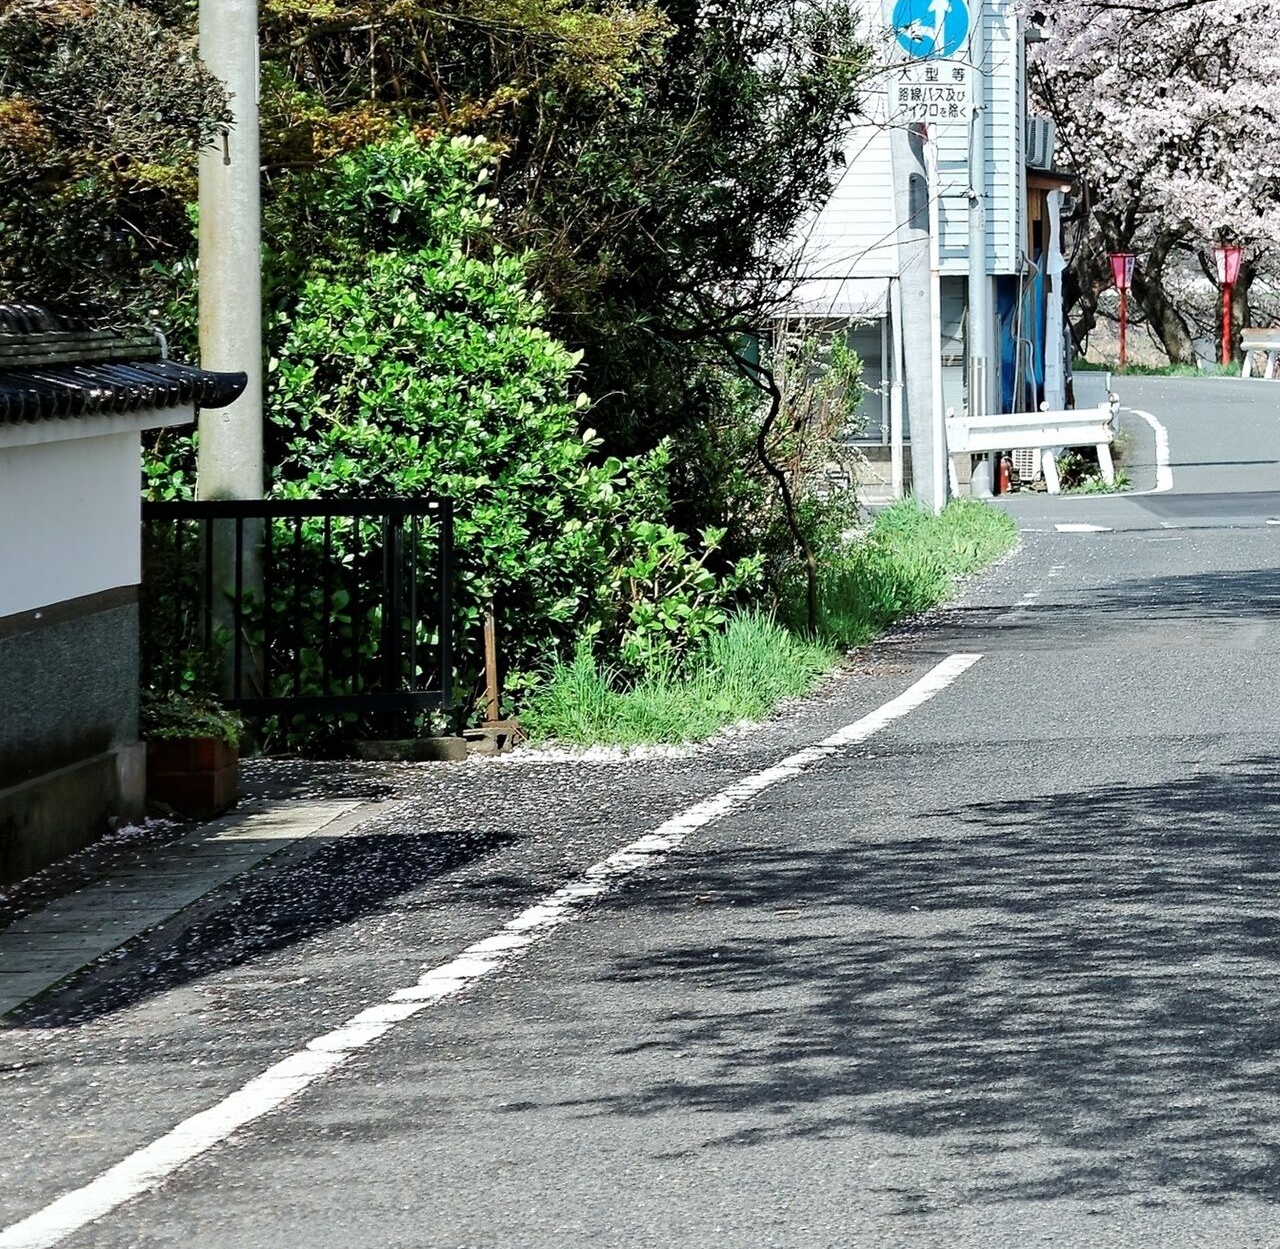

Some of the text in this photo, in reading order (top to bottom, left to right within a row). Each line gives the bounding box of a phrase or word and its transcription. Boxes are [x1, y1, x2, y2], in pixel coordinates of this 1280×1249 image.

[897, 66, 966, 82] 大型等
[898, 87, 966, 102] 路線バス及び
[898, 103, 967, 118] マイクロを除く
